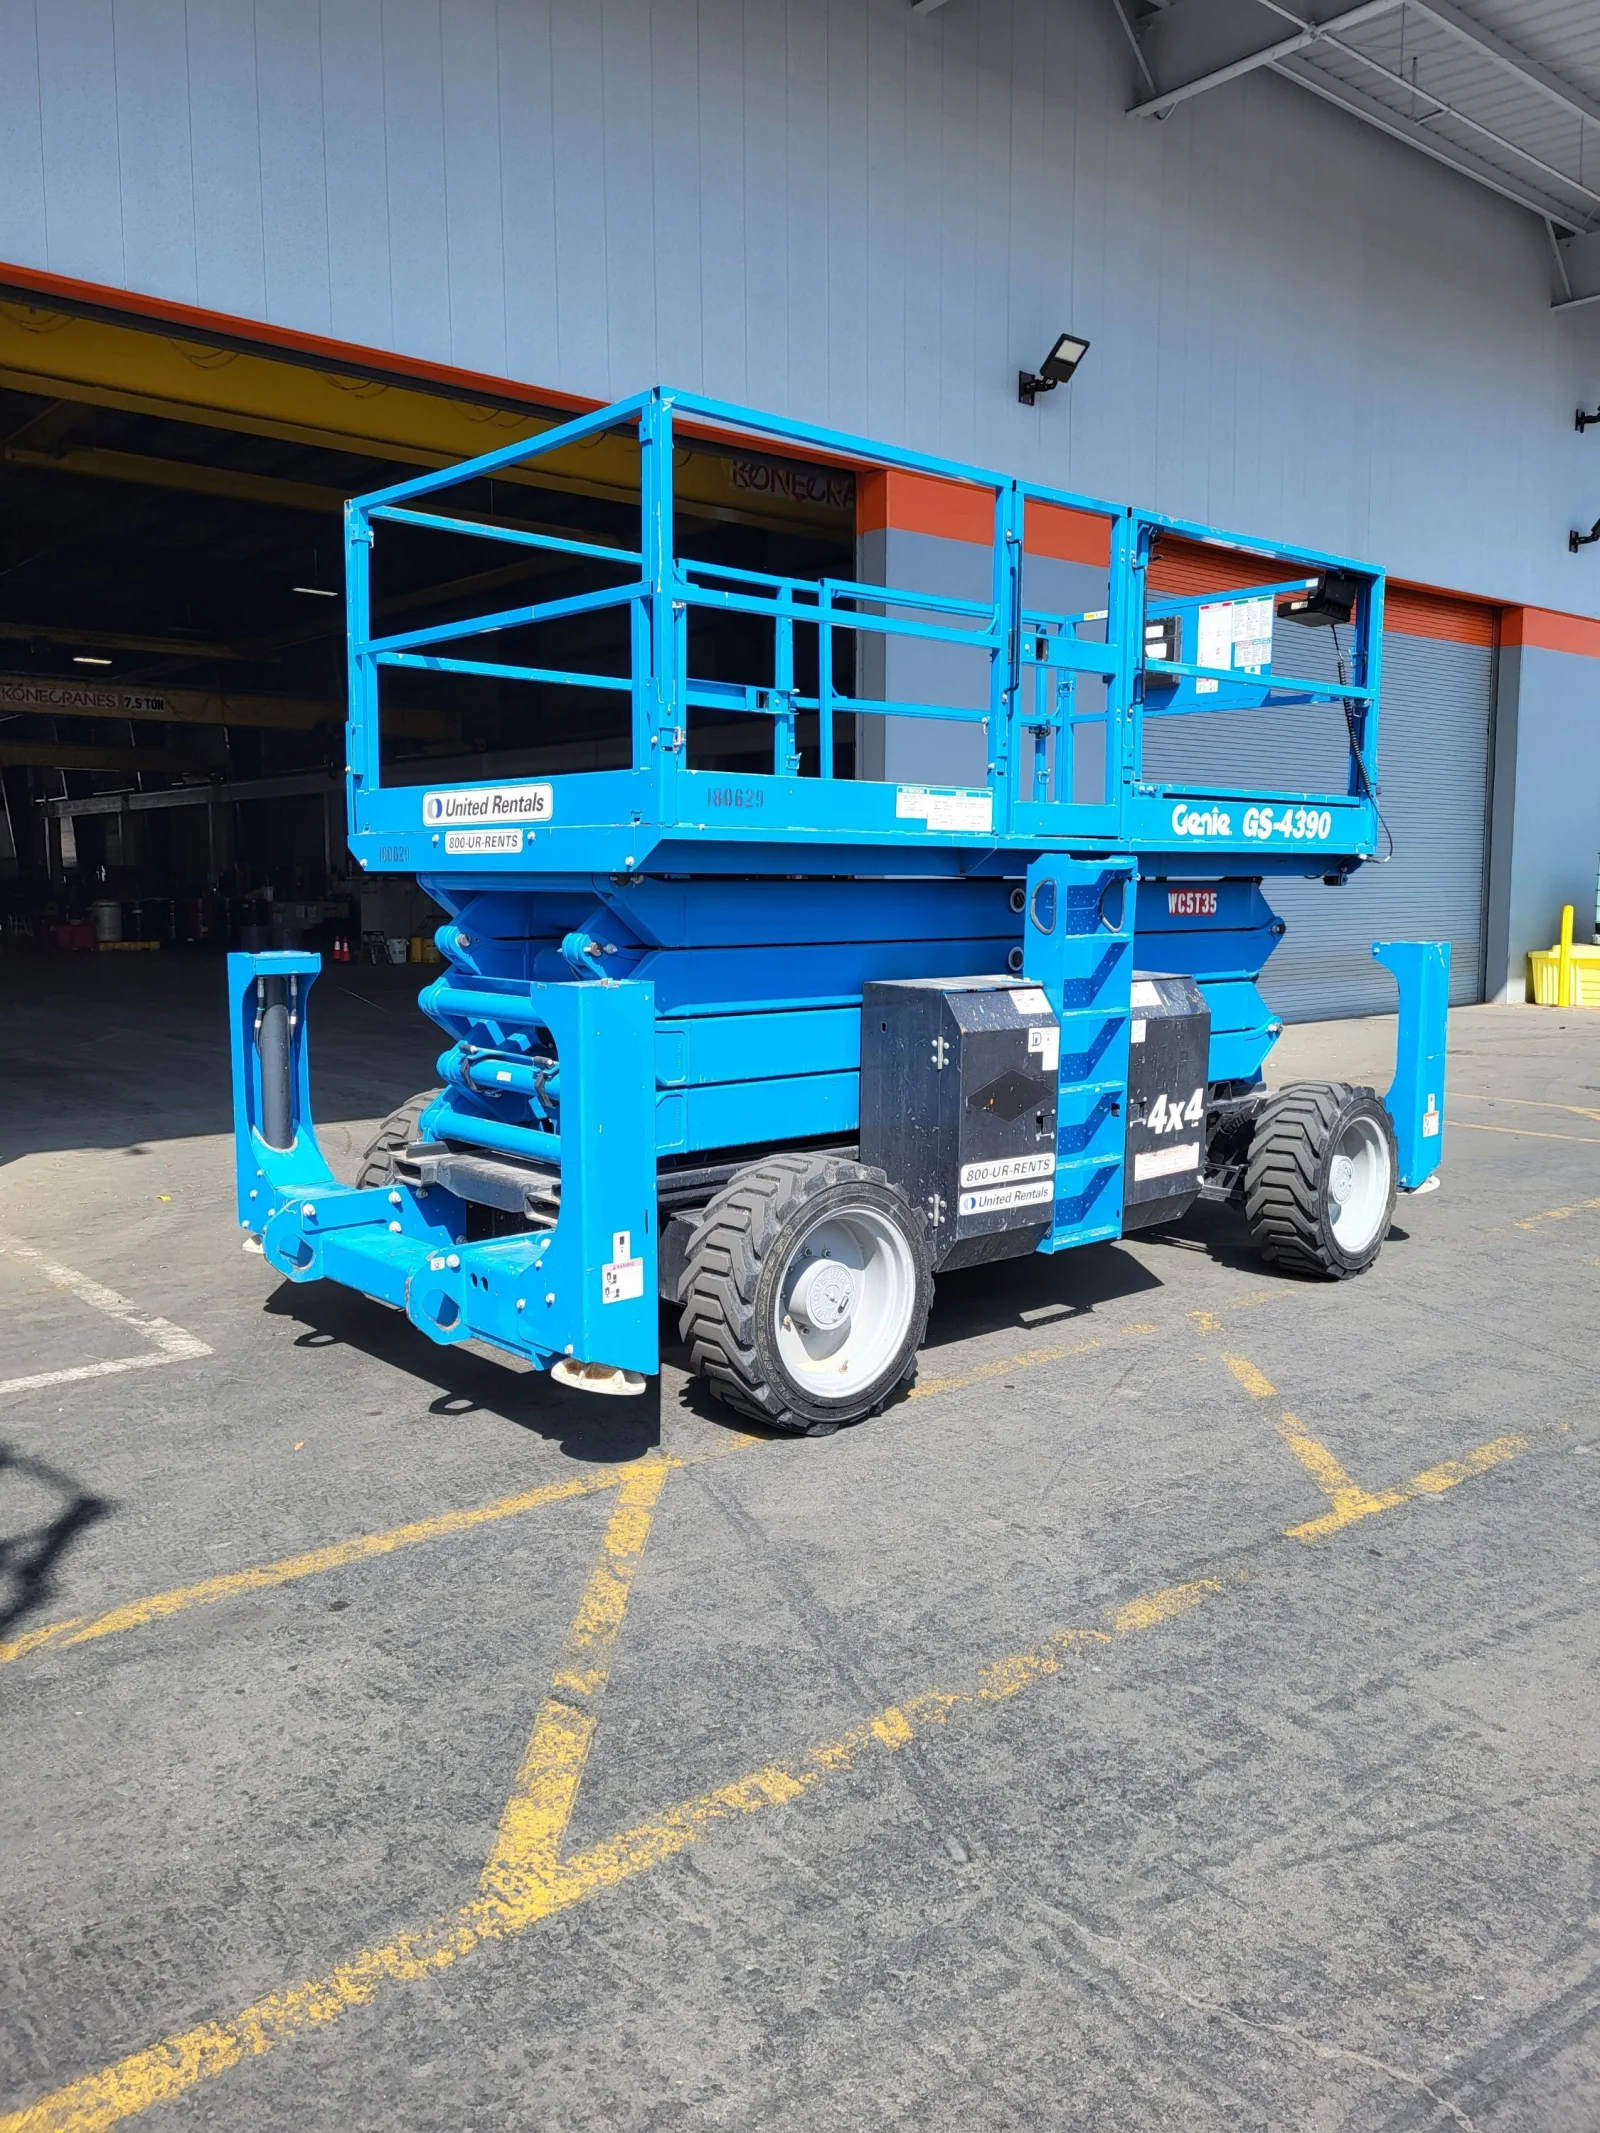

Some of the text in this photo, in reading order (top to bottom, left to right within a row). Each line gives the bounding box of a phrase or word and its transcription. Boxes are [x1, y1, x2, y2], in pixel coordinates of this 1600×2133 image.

[2, 686, 165, 711] KONECRANES 7.5 TON
[446, 792, 544, 817] United Rentals
[707, 788, 764, 808] 180629
[1171, 804, 1332, 840] Genie GS-4390
[448, 834, 518, 849] 800-UR-RENTS
[1168, 892, 1218, 914] WC5T35
[1147, 1088, 1204, 1135] 4x4
[966, 1158, 1050, 1182] 800-UR-RENTS
[978, 1186, 1049, 1208] United Rentals
